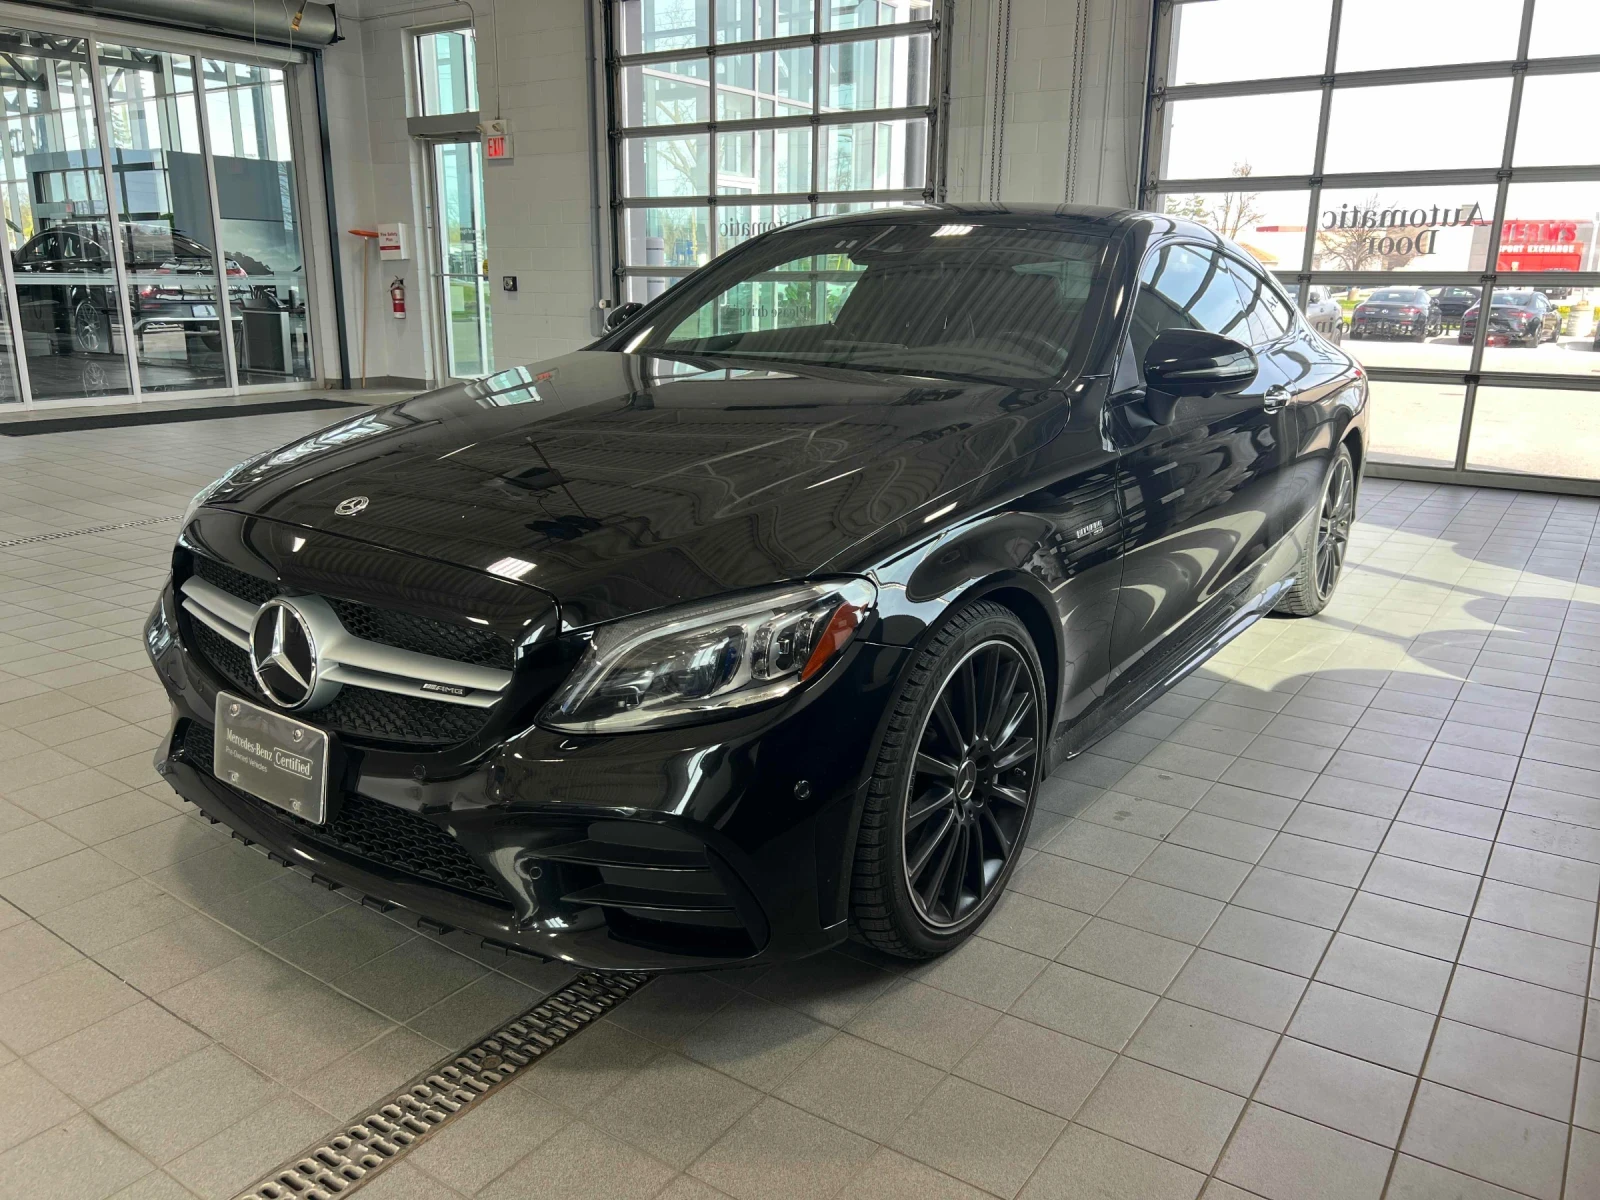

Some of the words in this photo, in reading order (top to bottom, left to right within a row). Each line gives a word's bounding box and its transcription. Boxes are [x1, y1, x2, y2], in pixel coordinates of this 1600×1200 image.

[487, 137, 504, 157] EXIT
[1527, 245, 1575, 253] EXCHANGE
[225, 746, 248, 764] Pre-Owned
[248, 757, 268, 773] Vehicles
[226, 728, 273, 761] Mercedes-Benz
[275, 751, 310, 775] Certified
